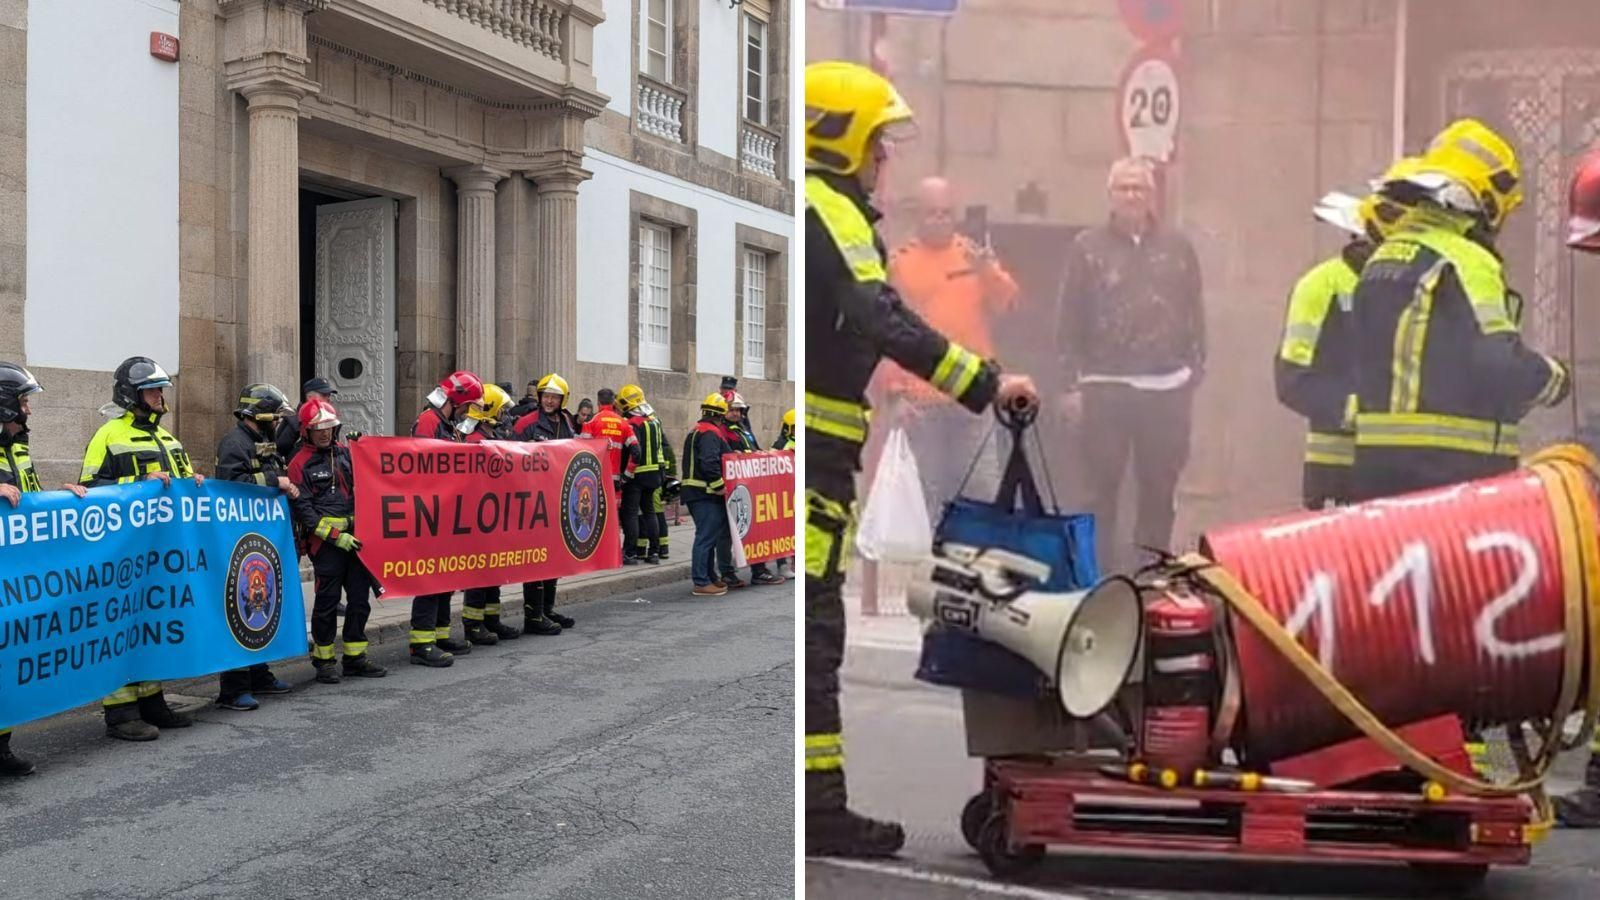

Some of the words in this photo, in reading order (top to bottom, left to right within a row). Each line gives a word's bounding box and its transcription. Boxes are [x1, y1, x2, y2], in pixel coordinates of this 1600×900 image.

[1130, 86, 1172, 128] 20
[381, 452, 514, 478] BOMBEIR@S
[522, 452, 549, 472] GES
[725, 456, 793, 480] BOMBEIROS
[0, 503, 123, 546] BEIR@S
[130, 496, 174, 528] GES
[181, 496, 211, 522] DE
[215, 497, 286, 522] GALICIA
[381, 494, 440, 539] EN
[452, 490, 549, 536] LOITA
[756, 492, 778, 523] EN
[782, 491, 795, 519] L
[383, 559, 435, 578] POLOS
[438, 553, 486, 574] NOSOS
[489, 547, 548, 568] DEREITOS
[744, 540, 771, 560] OLOS
[0, 553, 145, 607] NDONAD@S
[146, 547, 209, 576] POLA
[69, 602, 98, 634] DE
[105, 583, 195, 623] GALICIA
[1285, 530, 1565, 674] 112
